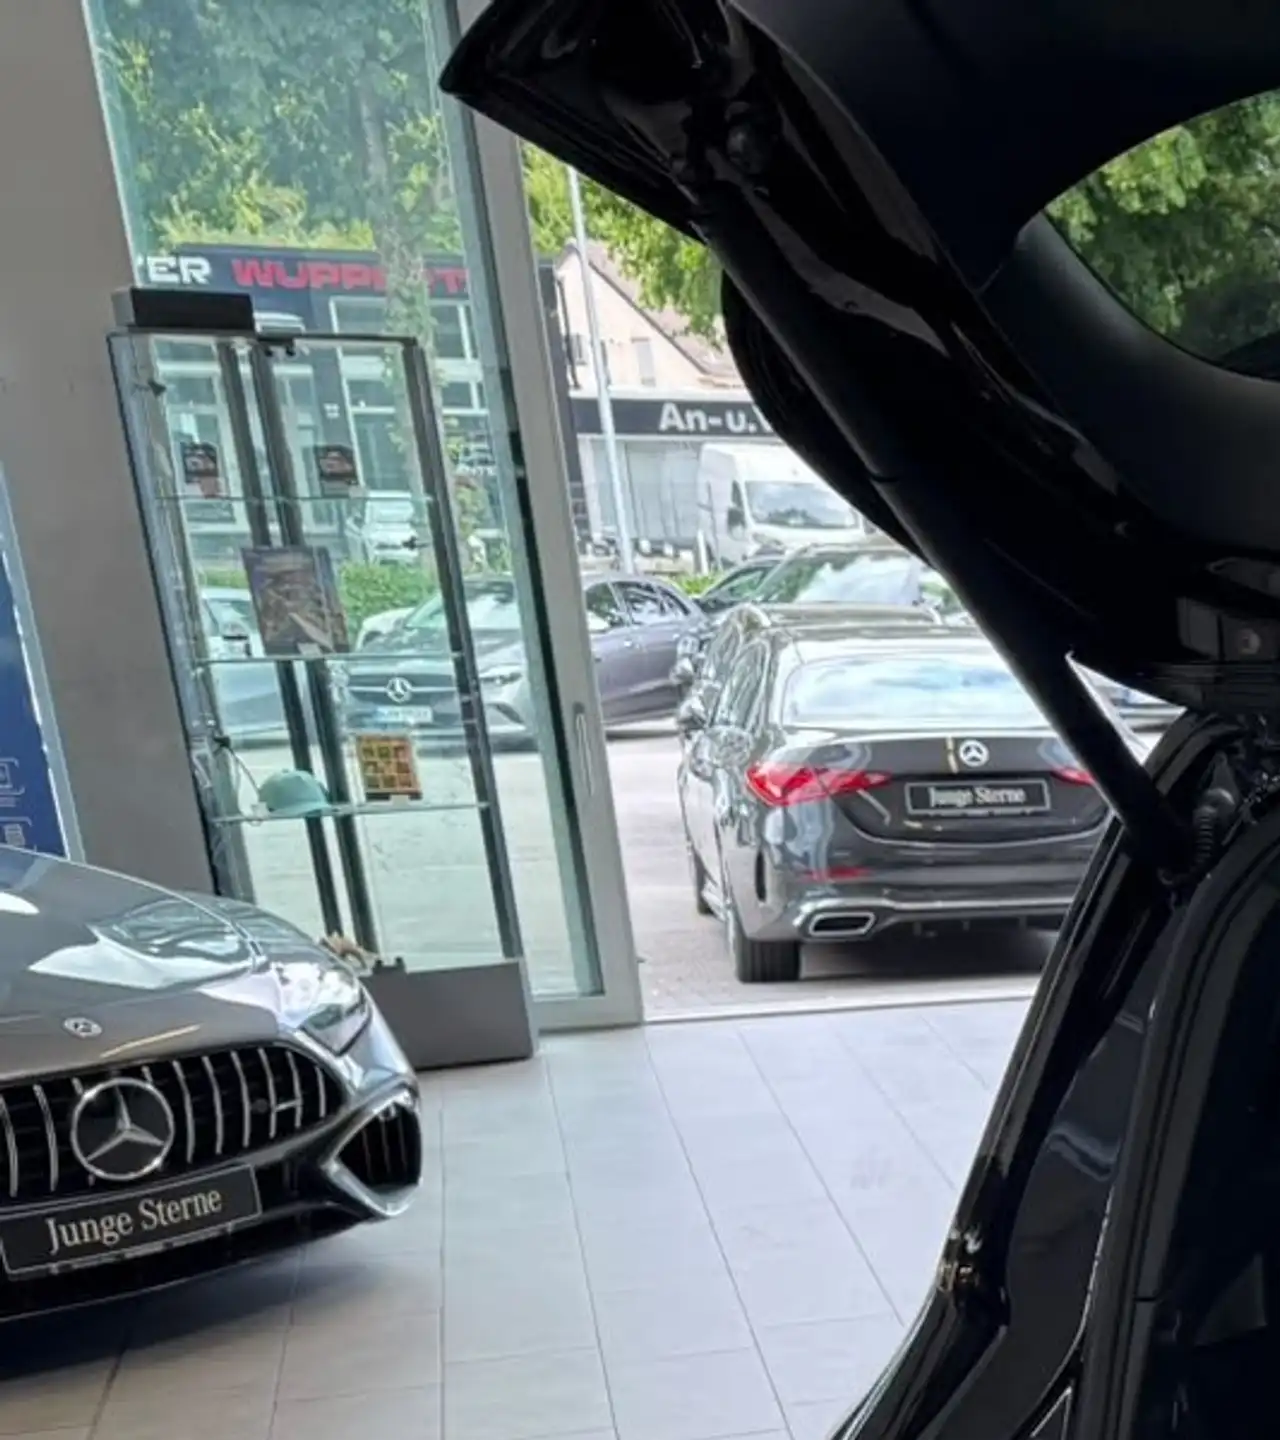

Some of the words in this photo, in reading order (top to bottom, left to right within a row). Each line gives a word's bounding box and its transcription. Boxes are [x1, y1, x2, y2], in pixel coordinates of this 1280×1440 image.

[137, 255, 212, 285] ER
[45, 1212, 135, 1256] Junge
[138, 1189, 223, 1232] Sterne
